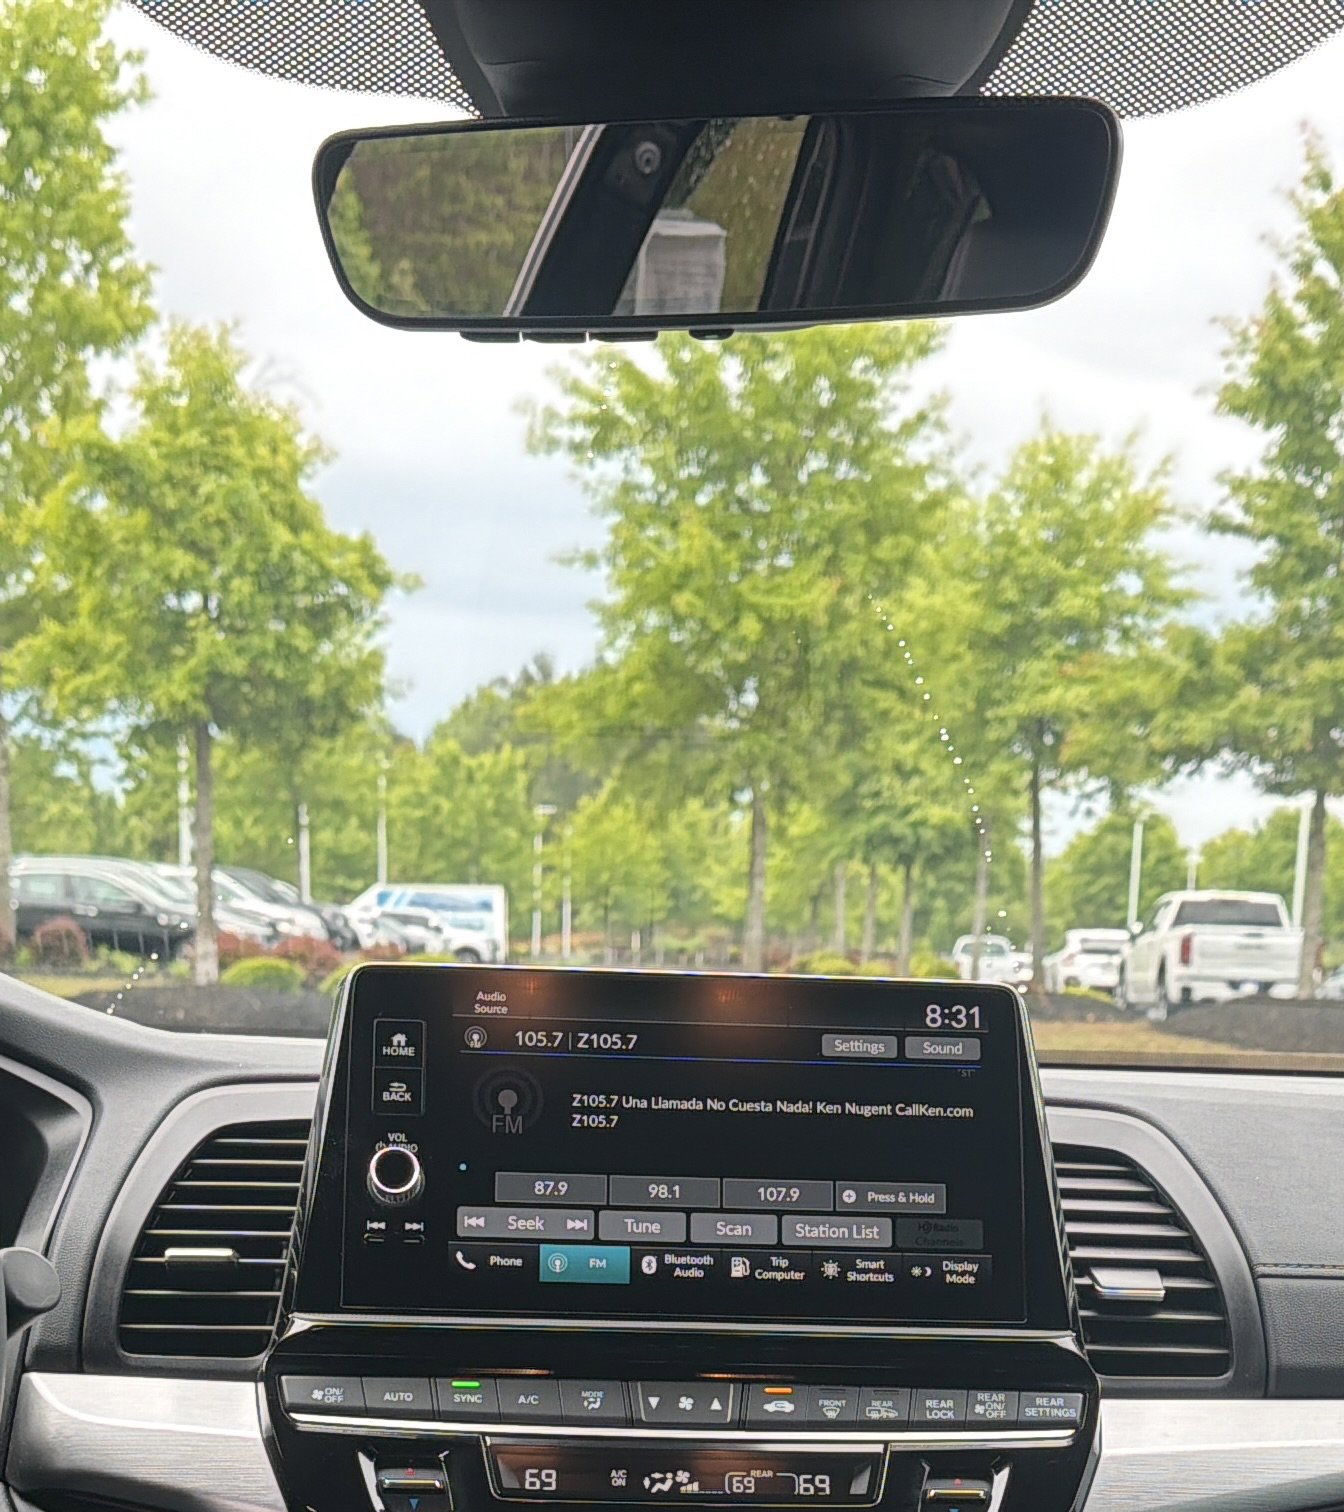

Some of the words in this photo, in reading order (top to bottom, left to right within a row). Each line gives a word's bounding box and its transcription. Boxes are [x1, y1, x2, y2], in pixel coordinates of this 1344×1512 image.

[476, 991, 506, 1002] Audio
[474, 1003, 508, 1014] Source
[925, 1004, 980, 1029] 8:31
[514, 1031, 563, 1047] 105.7
[577, 1033, 637, 1049] Z105.7
[382, 1046, 415, 1057] HOME
[834, 1039, 885, 1053] Settings
[923, 1041, 963, 1055] Sound
[382, 1091, 412, 1102] BACK
[571, 1094, 619, 1108] Z105.7
[622, 1096, 648, 1109] Una
[651, 1097, 704, 1111] Llamada
[706, 1099, 726, 1111] No
[729, 1099, 773, 1112] Cuesta
[776, 1100, 813, 1113] Nada!
[816, 1102, 842, 1114] Ken
[845, 1102, 892, 1117] Nugent
[895, 1103, 974, 1118] CallKen.com
[492, 1114, 523, 1135] FM
[571, 1114, 619, 1128] Z105.7
[387, 1132, 408, 1143] VOL
[534, 1181, 568, 1195] 87.9
[648, 1184, 680, 1198] 98.1
[757, 1186, 800, 1201] 107.9
[867, 1192, 895, 1203] Press
[897, 1193, 907, 1203] &
[909, 1192, 935, 1203] Hold
[507, 1216, 545, 1230] Seek
[624, 1219, 661, 1233] Tune
[716, 1221, 752, 1236] Scan
[795, 1223, 849, 1239] Station
[852, 1225, 880, 1239] List
[489, 1255, 523, 1267] Phone
[589, 1258, 607, 1269] FM
[664, 1254, 714, 1266] Bluetooth
[770, 1256, 789, 1269] Trip
[855, 1258, 884, 1269] Smart
[673, 1267, 704, 1278] Audio
[942, 1260, 979, 1274] Display
[755, 1268, 805, 1281] Computer
[846, 1271, 894, 1283] Shortcuts
[945, 1273, 976, 1284] Mode
[324, 1395, 344, 1404] OFF
[383, 1391, 413, 1402] AUTO
[453, 1394, 482, 1404] SYNC
[518, 1394, 539, 1405] A/C
[581, 1390, 604, 1398] MODE
[977, 1393, 1006, 1402] REAR
[818, 1399, 846, 1408] FRONT
[871, 1400, 894, 1408] REAR
[926, 1399, 954, 1410] REAR
[1035, 1397, 1064, 1407] REAR
[926, 1409, 954, 1419] LOCK
[985, 1409, 1007, 1418] OFF
[1024, 1407, 1077, 1418] SETTINGS
[610, 1470, 627, 1478] A/C
[750, 1470, 774, 1478] REAR
[524, 1469, 556, 1491] 69
[611, 1478, 626, 1487] ON
[732, 1477, 755, 1494] 69
[799, 1475, 830, 1495] 69
